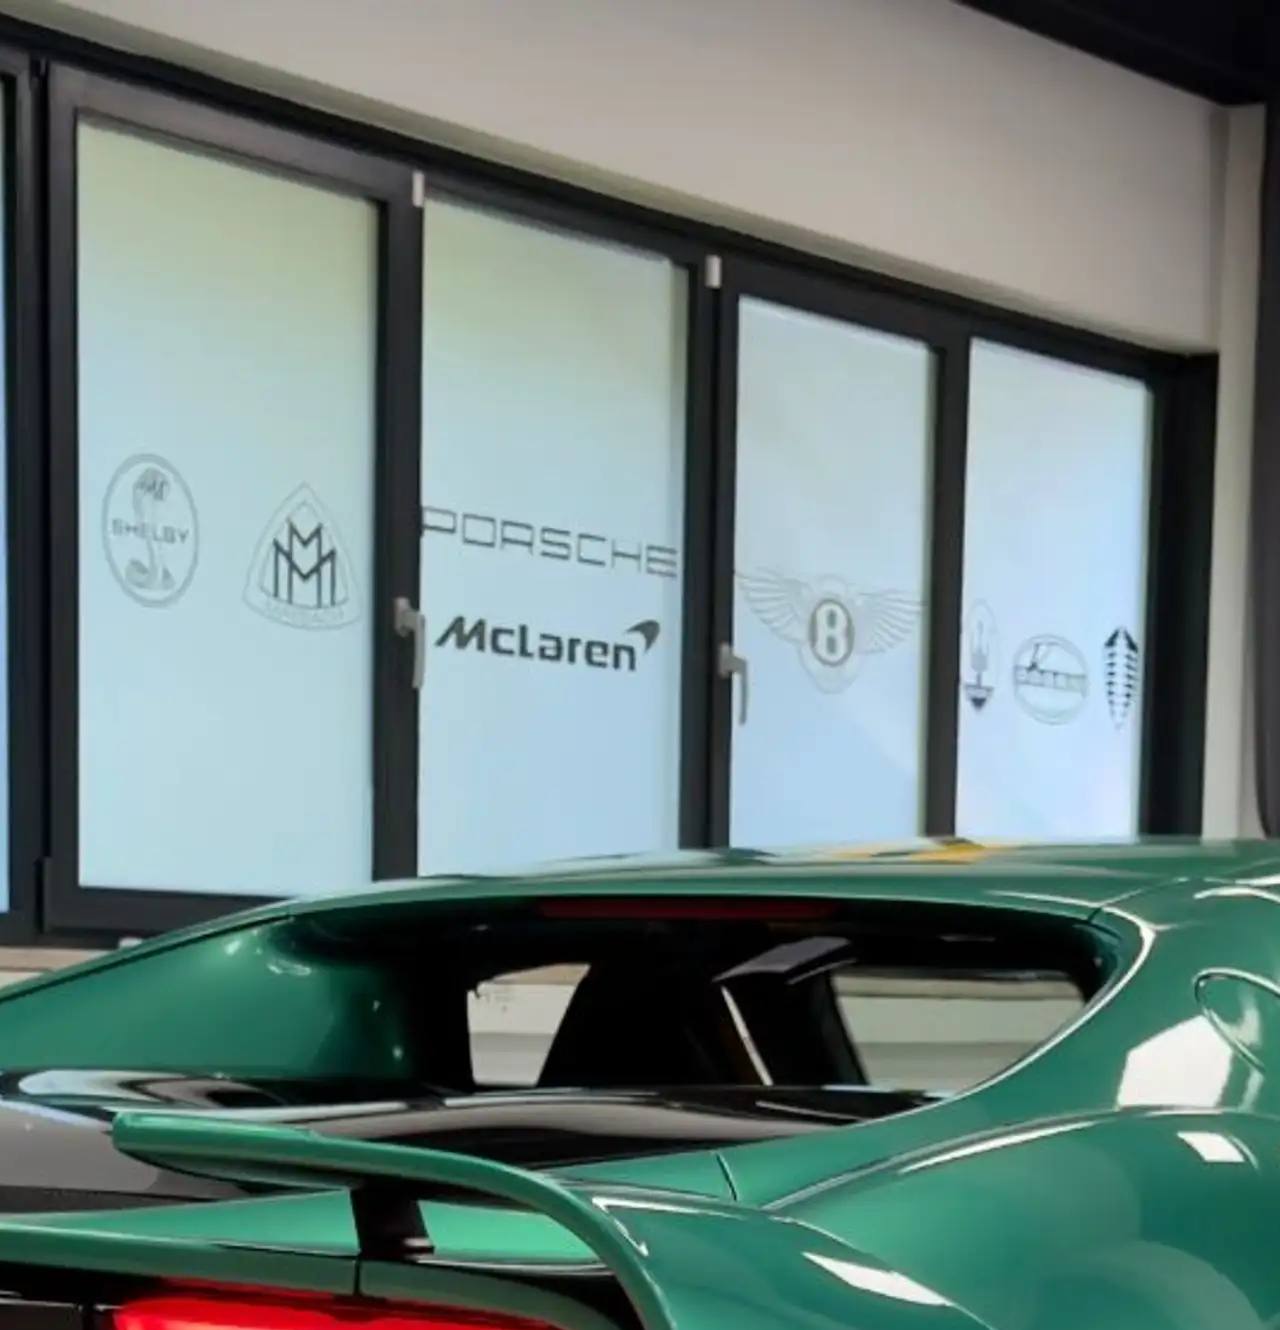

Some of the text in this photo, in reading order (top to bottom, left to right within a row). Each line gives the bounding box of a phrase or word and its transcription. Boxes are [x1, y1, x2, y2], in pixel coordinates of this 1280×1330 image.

[111, 517, 189, 545] SHELBY
[420, 505, 678, 579] PORSCHE
[434, 615, 637, 671] McLaren
